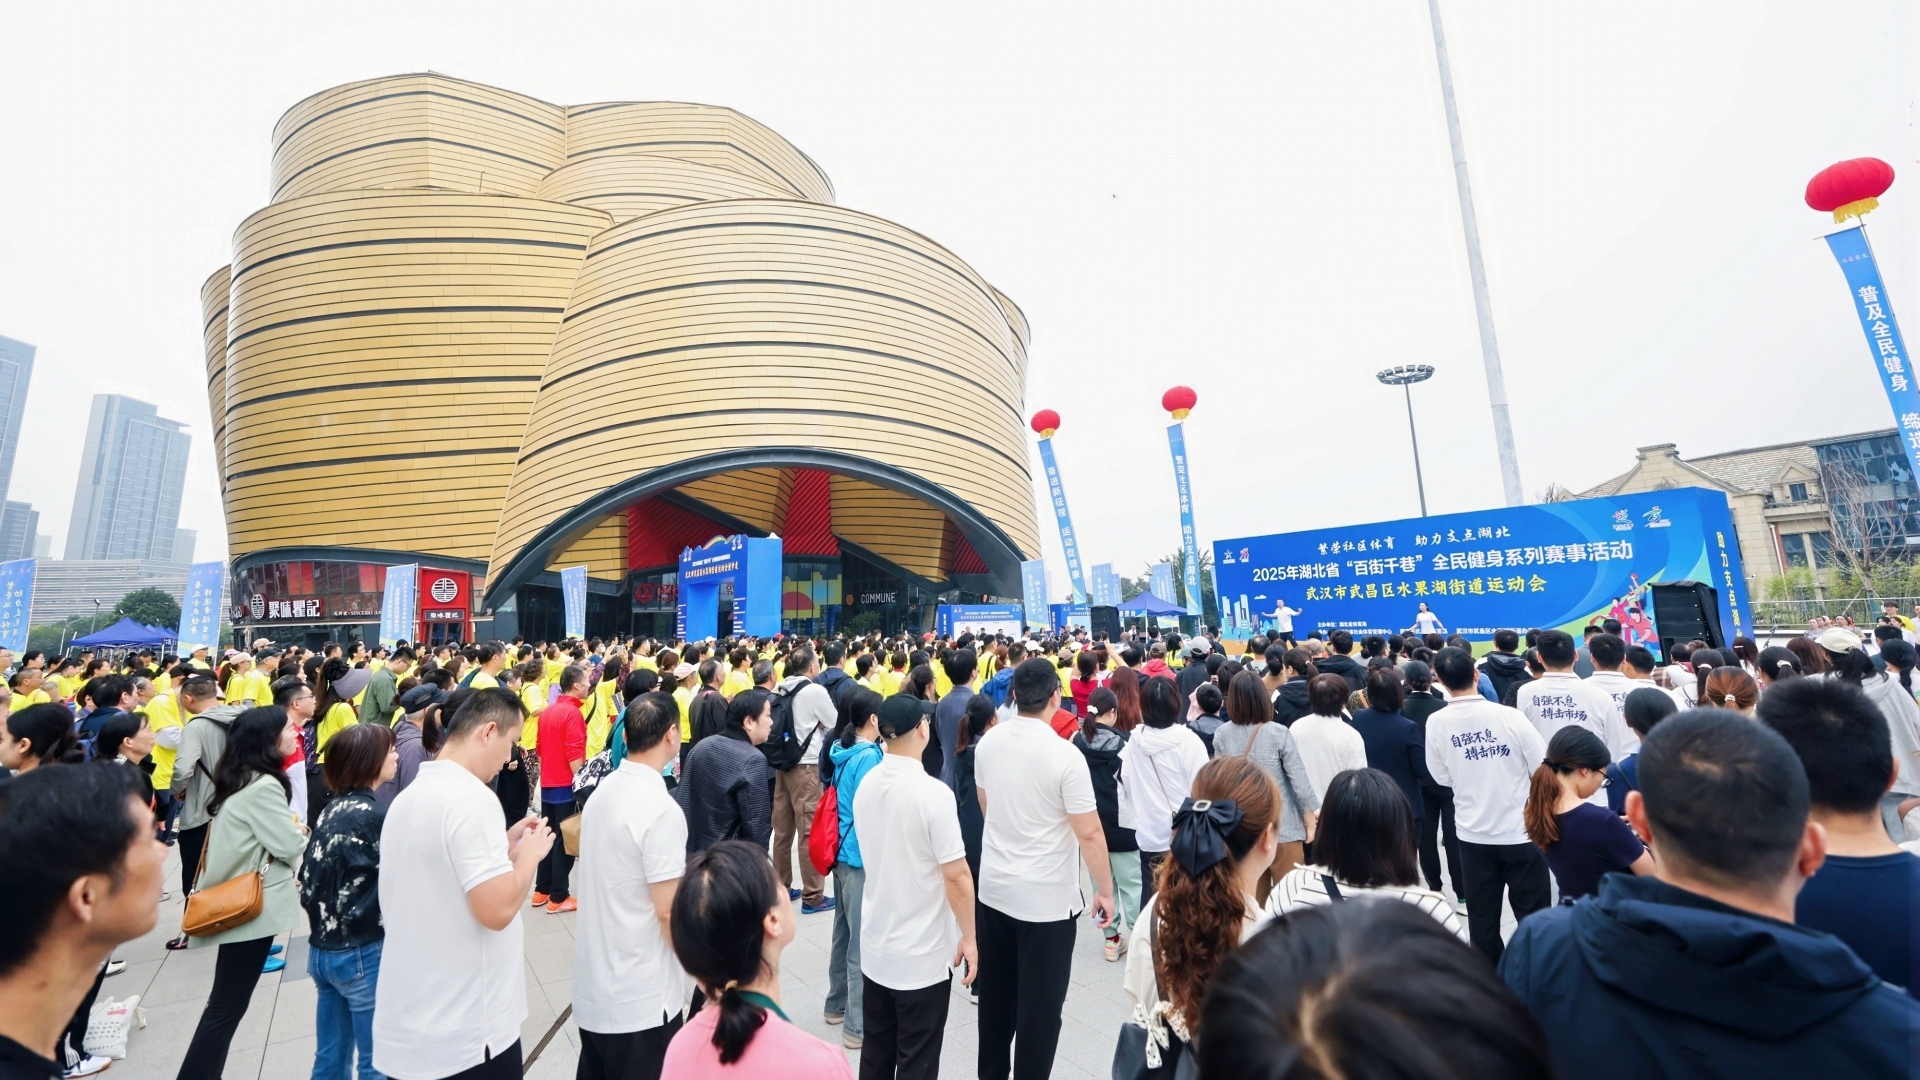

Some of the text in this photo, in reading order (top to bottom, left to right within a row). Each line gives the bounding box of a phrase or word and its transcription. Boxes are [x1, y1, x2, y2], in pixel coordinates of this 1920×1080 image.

[1857, 285, 1920, 467] 普及全民健身 缔造
[1047, 466, 1081, 580] 奋进新征程 运动促健康
[1175, 455, 1197, 586] 繁荣社区体育 助力支点湖北
[1317, 525, 1512, 556] 繁荣社区体育 助力支点湖北
[860, 592, 896, 604] COMMUNE
[1305, 574, 1548, 601] 武汉市武昌区水果湖街道运动会
[1531, 694, 1578, 708] 自强不息
[1541, 707, 1588, 722] 搏击市场
[1450, 728, 1498, 748] 自强不息
[1464, 744, 1511, 761] 搏击市场
